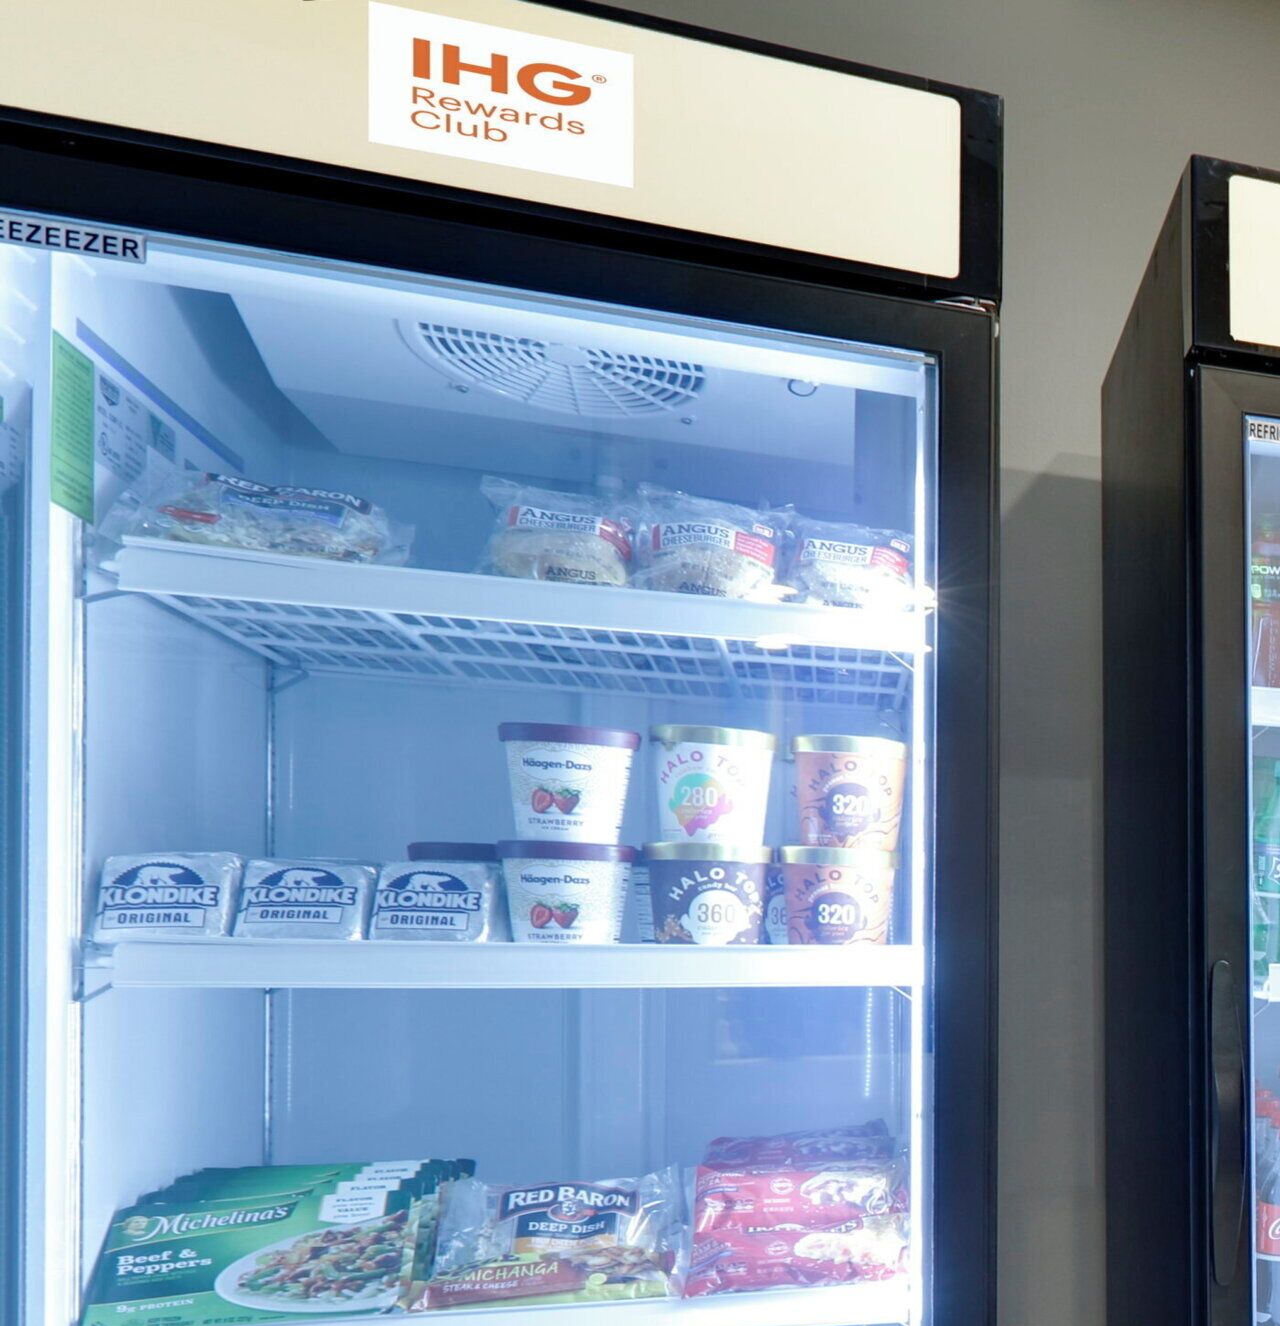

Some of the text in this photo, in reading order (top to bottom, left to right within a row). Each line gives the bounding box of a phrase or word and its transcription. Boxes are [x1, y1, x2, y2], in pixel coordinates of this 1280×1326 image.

[411, 37, 593, 106] IHG
[411, 86, 586, 136] Rewards
[410, 109, 508, 143] Club
[519, 517, 597, 532] CHEESEBURGER
[520, 508, 596, 524] ANGUS
[662, 532, 731, 548] CHEESEBURGER
[663, 523, 730, 539] ANGUS
[805, 540, 868, 556] ANGUS
[545, 566, 597, 581] ANGUS
[522, 756, 592, 772] Häagen-Dazs
[681, 786, 719, 808] 280
[528, 817, 584, 828] STRAWBERRY
[520, 873, 591, 886] Häagen-Dazs
[668, 866, 726, 901] HALO
[100, 885, 221, 907] KLONDIKE
[244, 885, 358, 906] KLONDIKE
[375, 888, 482, 911] KLONDIKE
[117, 911, 191, 924] ORIGINAL
[258, 908, 329, 921] ORIGINAL
[390, 913, 456, 927] ORIGINAL
[697, 903, 736, 923] 360
[818, 903, 856, 925] 320
[509, 1186, 632, 1209] RED BARON
[142, 1204, 289, 1242] Michelina's
[529, 1220, 605, 1234] DEEP DISH
[116, 1256, 214, 1277] Peppers
[117, 1248, 198, 1268] Beef &
[139, 1299, 195, 1312] PROTEIN
